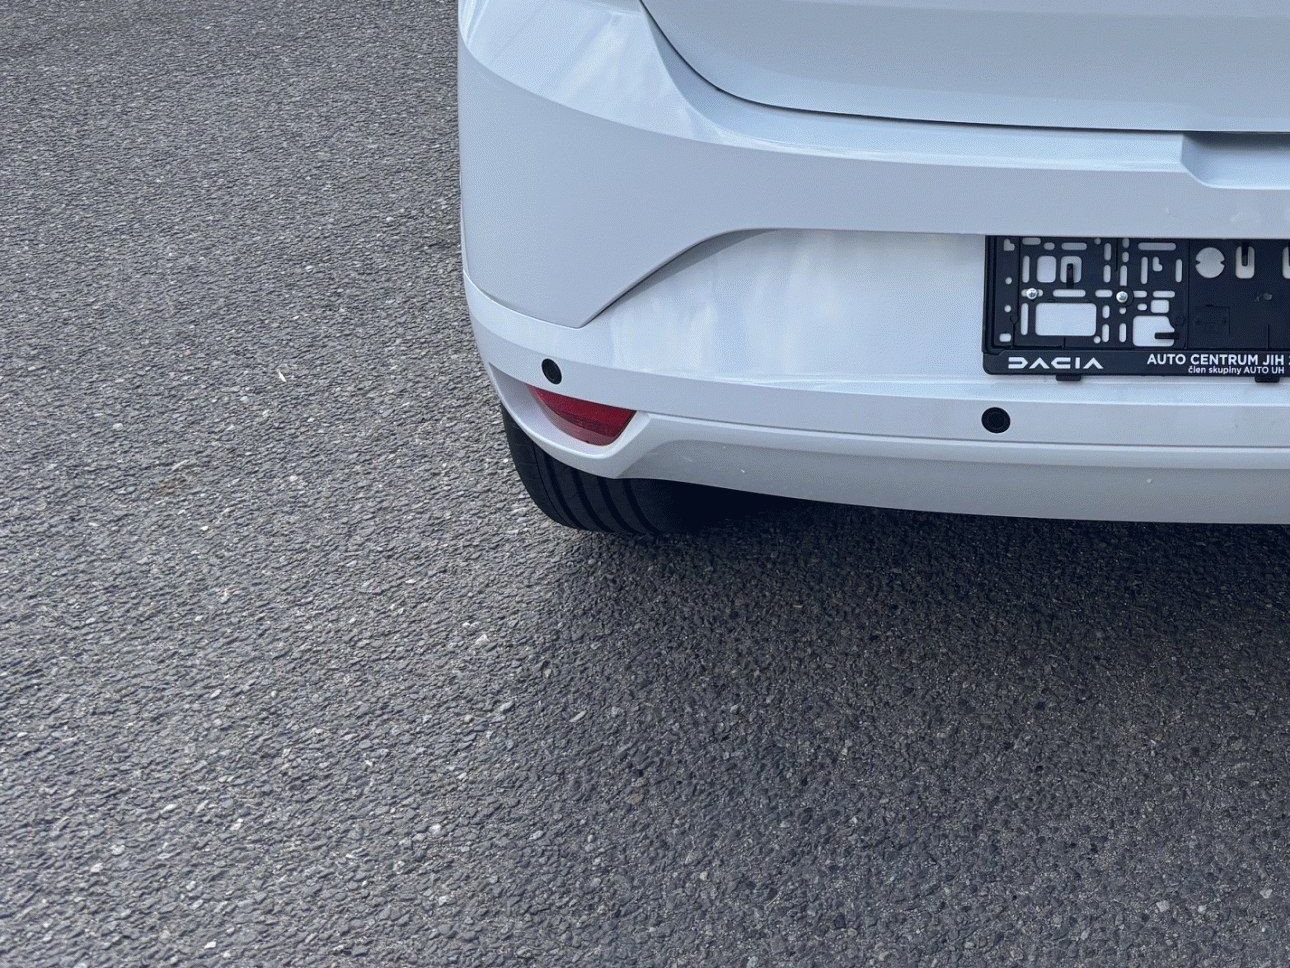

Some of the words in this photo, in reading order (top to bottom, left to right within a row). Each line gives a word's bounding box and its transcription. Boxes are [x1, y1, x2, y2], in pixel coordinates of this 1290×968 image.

[1007, 356, 1104, 370] DACIA
[1147, 353, 1187, 365] AUTO
[1190, 353, 1259, 366] CENTRUM
[1263, 354, 1284, 366] JIH
[1188, 365, 1207, 374] člen
[1208, 365, 1241, 375] skupiny
[1243, 366, 1269, 374] AUTO
[1271, 366, 1285, 374] UH
